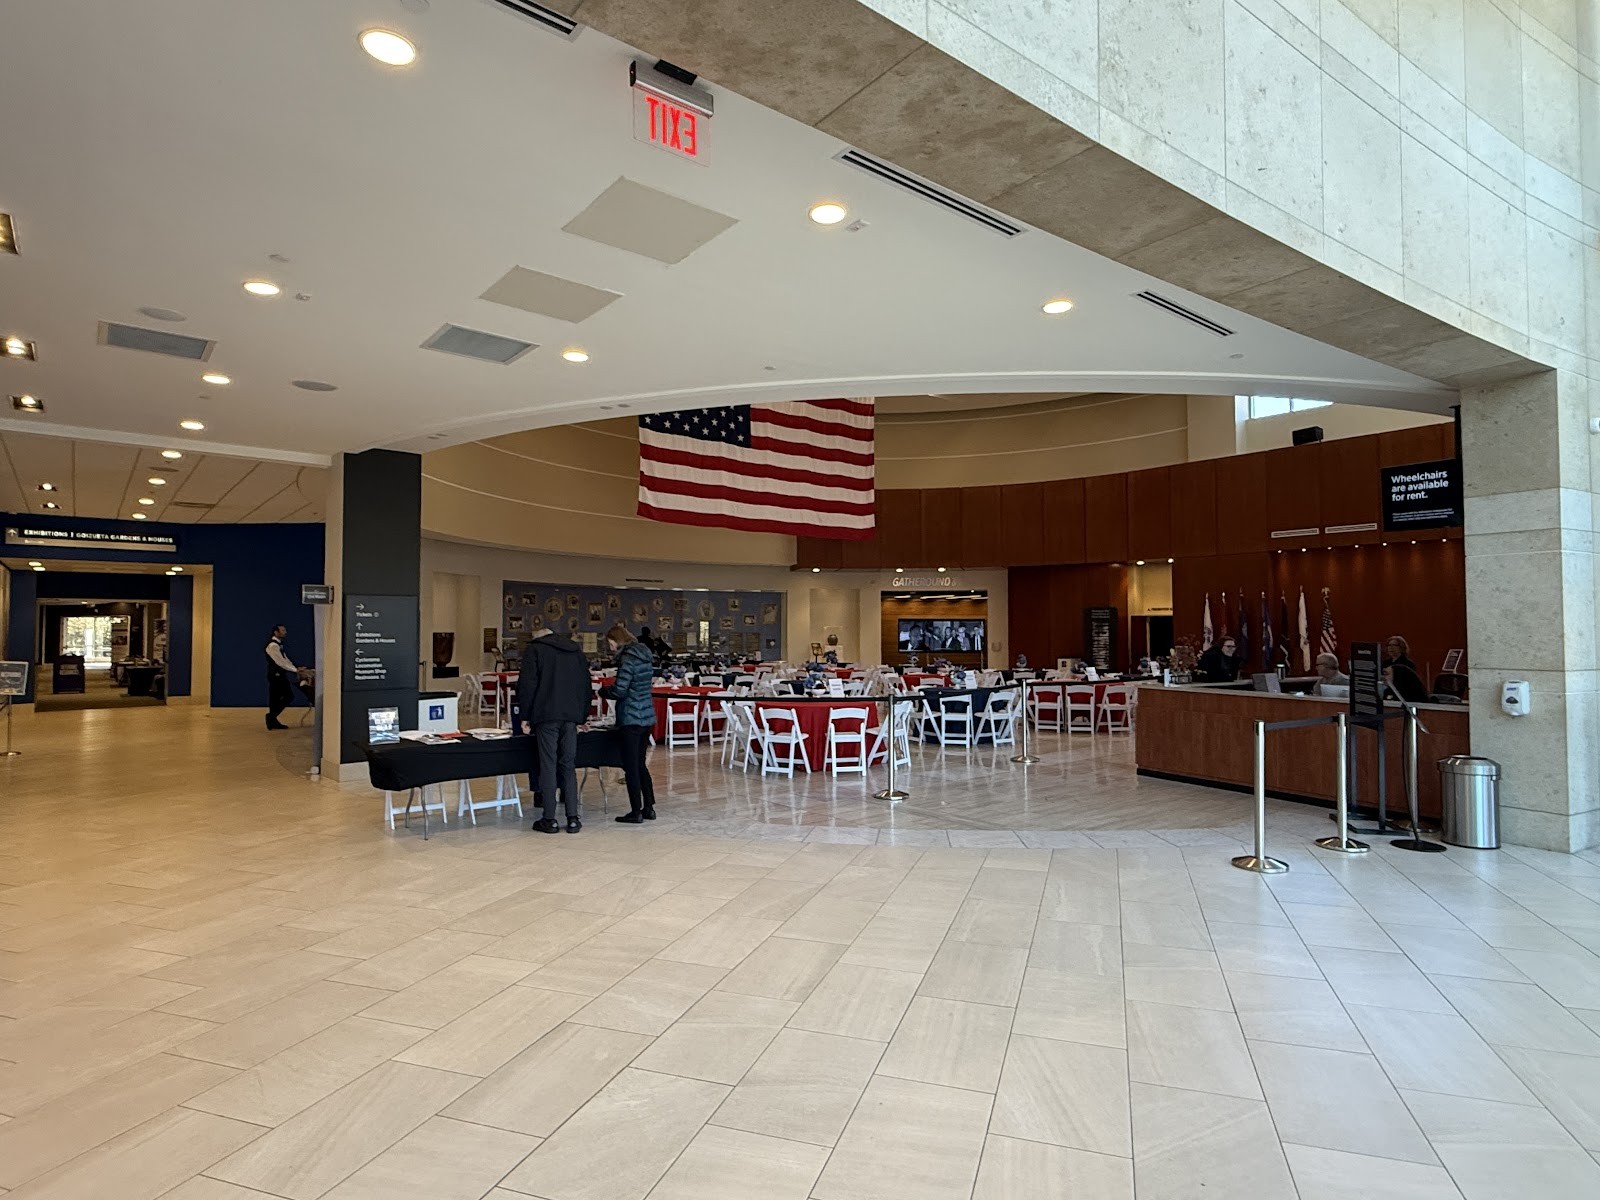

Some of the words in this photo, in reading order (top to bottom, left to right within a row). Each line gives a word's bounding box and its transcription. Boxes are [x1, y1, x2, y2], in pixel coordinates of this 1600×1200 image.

[1391, 470, 1448, 484] Wheelchairs
[1391, 485, 1406, 493] are
[1407, 479, 1449, 491] available
[1392, 493, 1405, 502] for
[1406, 490, 1428, 500] rent.
[24, 529, 68, 538] EXHIBITIONS
[110, 534, 142, 542] GARDENS
[147, 536, 173, 544] HOUSES
